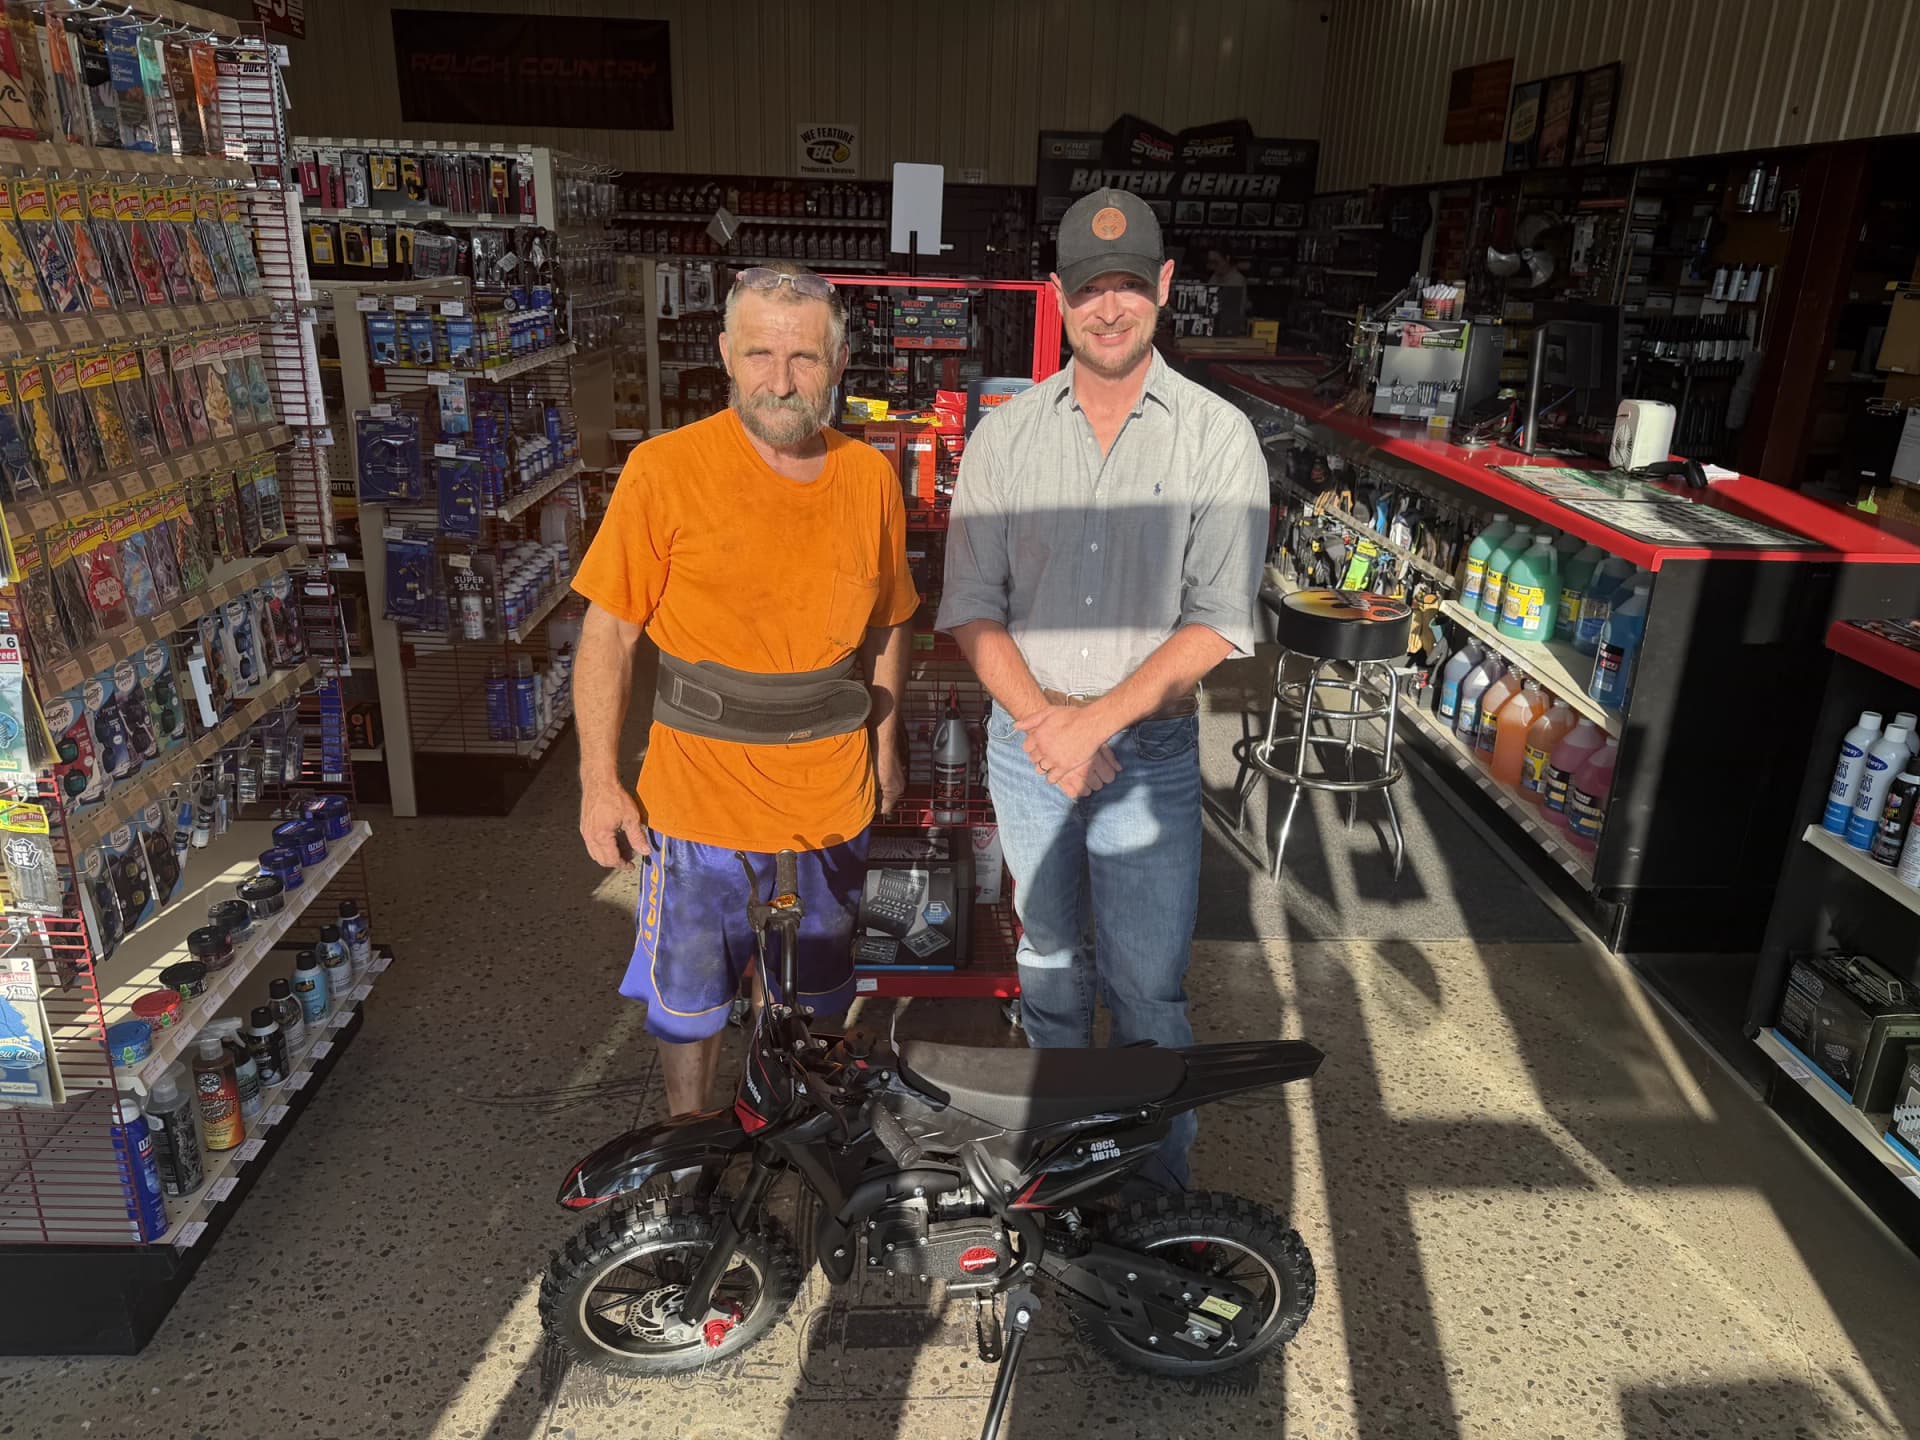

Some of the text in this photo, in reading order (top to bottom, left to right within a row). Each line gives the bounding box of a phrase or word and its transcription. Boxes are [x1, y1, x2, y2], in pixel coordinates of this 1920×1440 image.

[409, 52, 657, 82] ROUGH COUNTRY
[800, 127, 855, 144] WE FEATURE
[812, 144, 836, 159] BG
[1069, 168, 1281, 196] BATTERY CENTER
[454, 575, 485, 584] SUPER
[458, 583, 481, 591] SEAL
[6, 637, 16, 648] 6
[929, 903, 943, 913] 5
[21, 961, 30, 971] 2
[1090, 1138, 1116, 1152] 49CC
